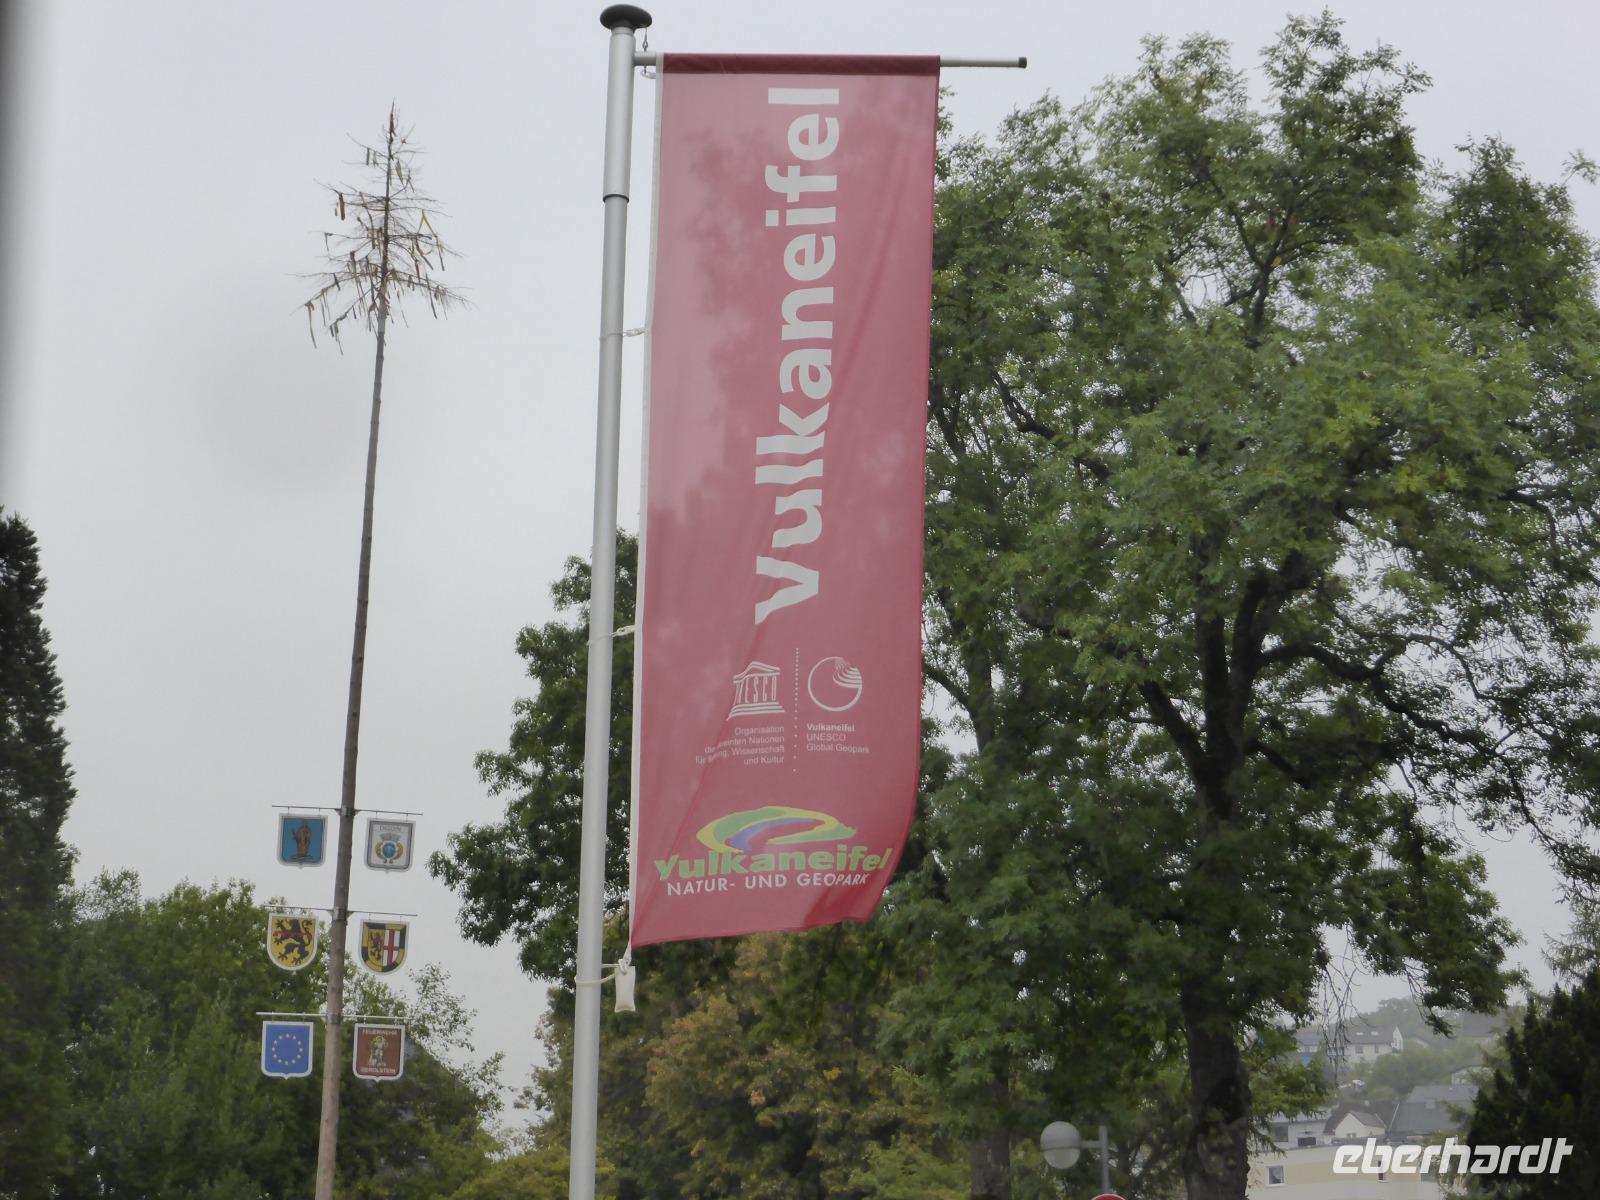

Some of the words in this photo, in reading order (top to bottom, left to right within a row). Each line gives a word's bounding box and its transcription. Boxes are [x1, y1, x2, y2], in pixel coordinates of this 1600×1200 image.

[755, 87, 840, 625] Vulkaneifel
[734, 725, 785, 737] Organisation
[806, 722, 855, 732] Vulkaneifel
[749, 735, 785, 745] Nationen
[806, 733, 847, 742] UNESCO
[806, 743, 833, 752] Global
[835, 743, 870, 754] Geopark
[743, 756, 758, 766] und
[760, 755, 785, 765] Kultur
[654, 844, 893, 881] Vulkaneifel
[667, 878, 736, 897] NATUR-
[745, 873, 787, 889] UND
[796, 872, 870, 886] GEOPARK
